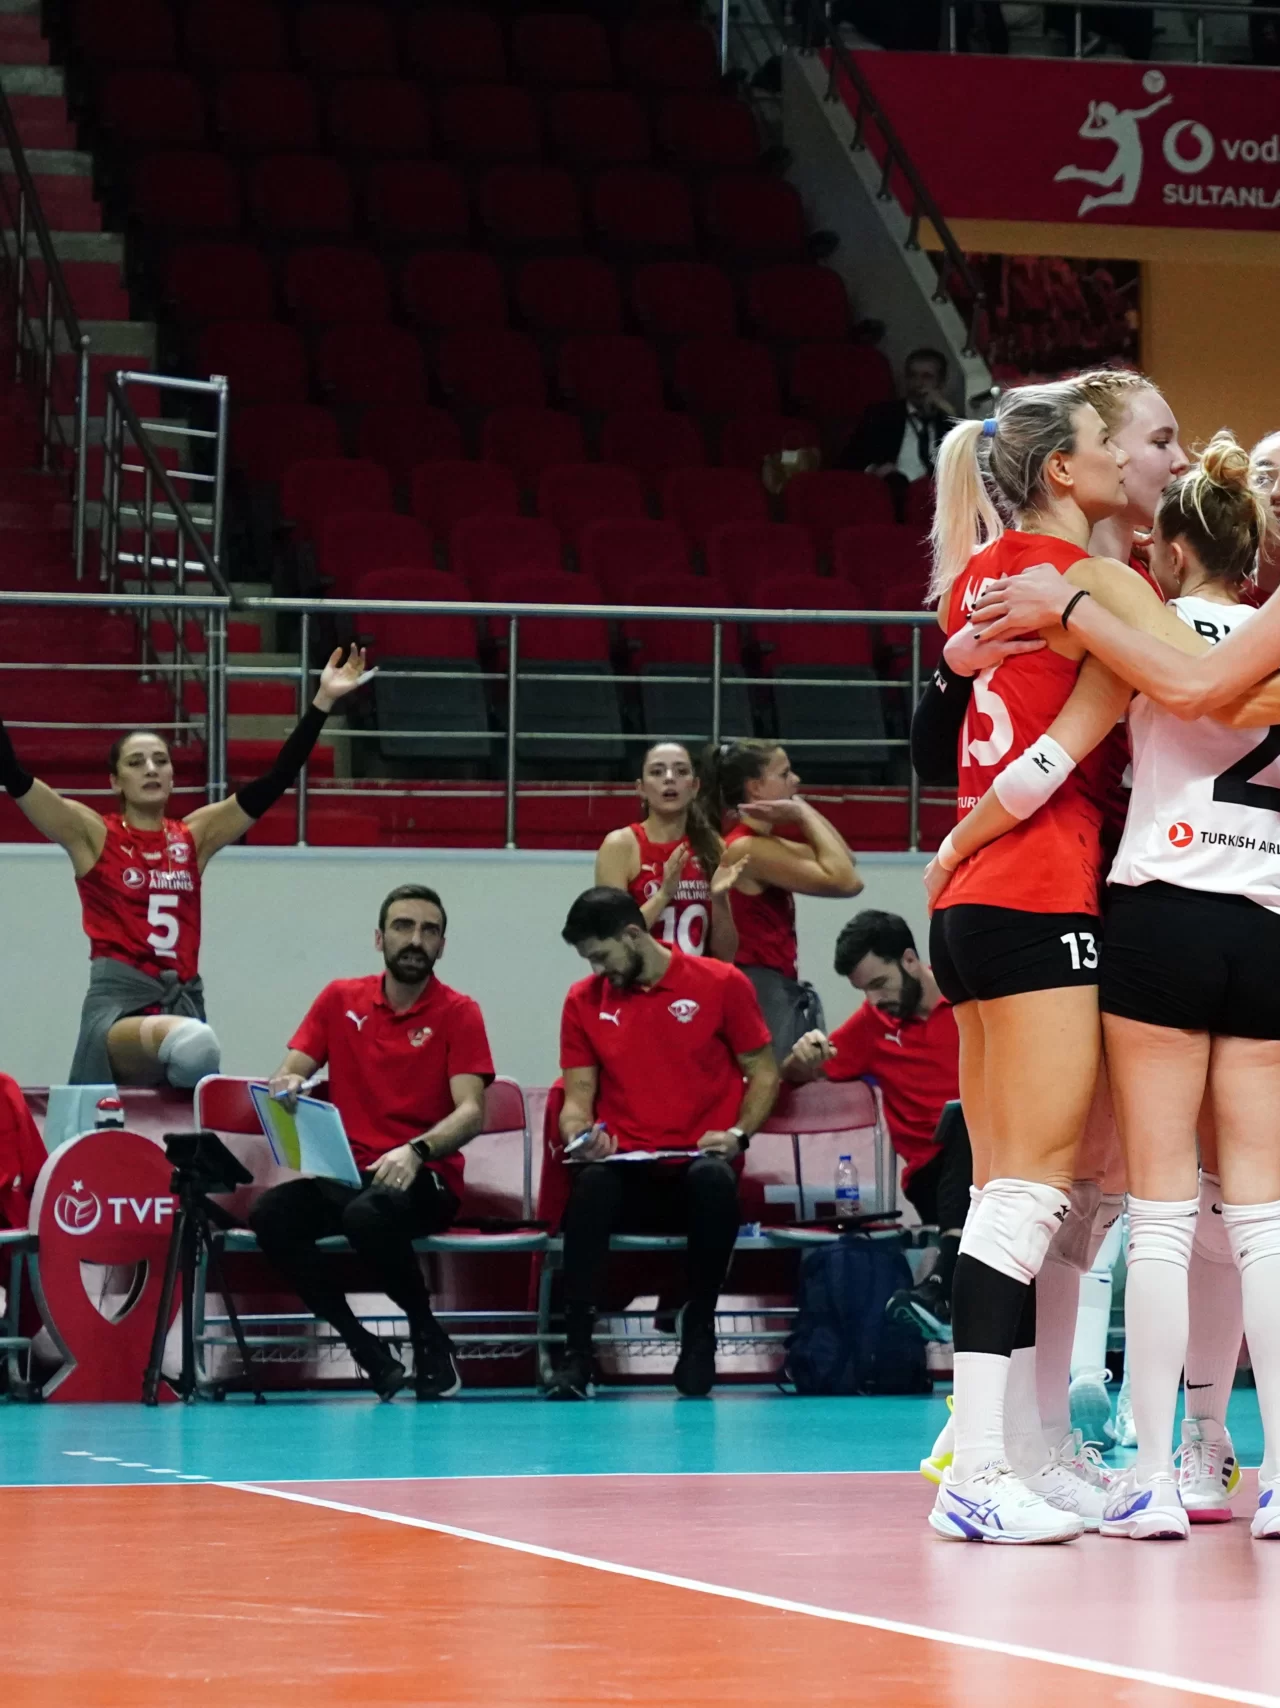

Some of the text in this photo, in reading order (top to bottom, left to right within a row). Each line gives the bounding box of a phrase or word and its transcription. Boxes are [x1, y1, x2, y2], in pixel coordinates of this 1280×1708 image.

[1200, 831, 1256, 850] TURKISH
[147, 894, 179, 950] 5
[659, 903, 709, 957] 10
[1060, 932, 1099, 970] 13
[107, 1197, 174, 1225] TVF
